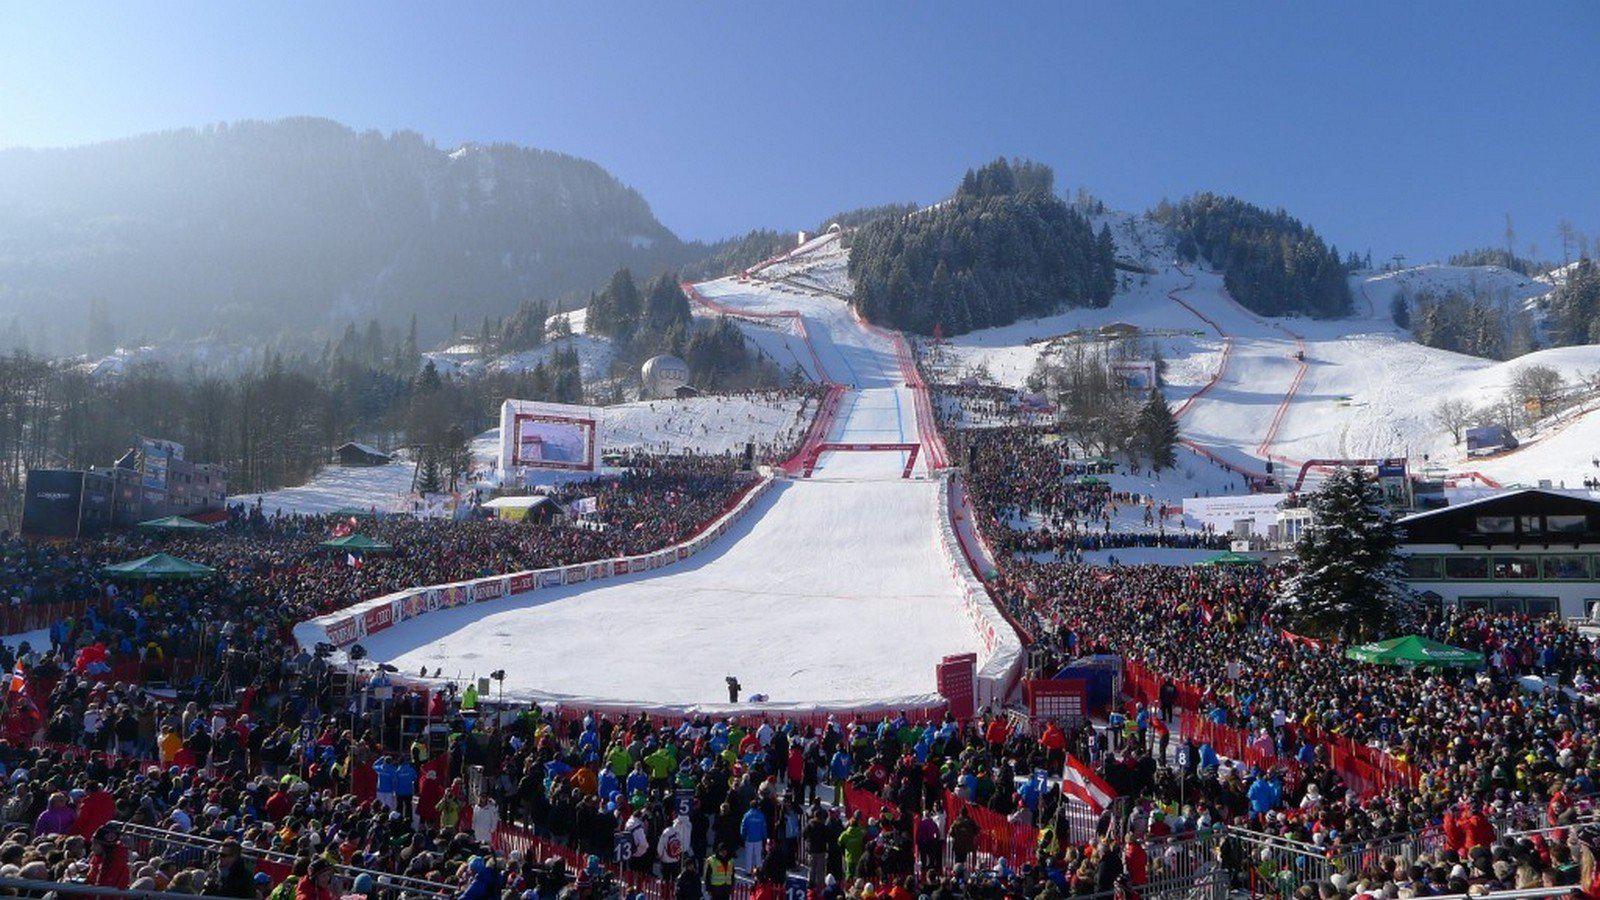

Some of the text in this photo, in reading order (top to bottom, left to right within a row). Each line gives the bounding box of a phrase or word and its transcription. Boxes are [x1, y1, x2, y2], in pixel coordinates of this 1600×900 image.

[1179, 752, 1187, 765] 8
[1037, 777, 1045, 790] 7
[679, 799, 690, 814] 5
[613, 842, 632, 861] 13
